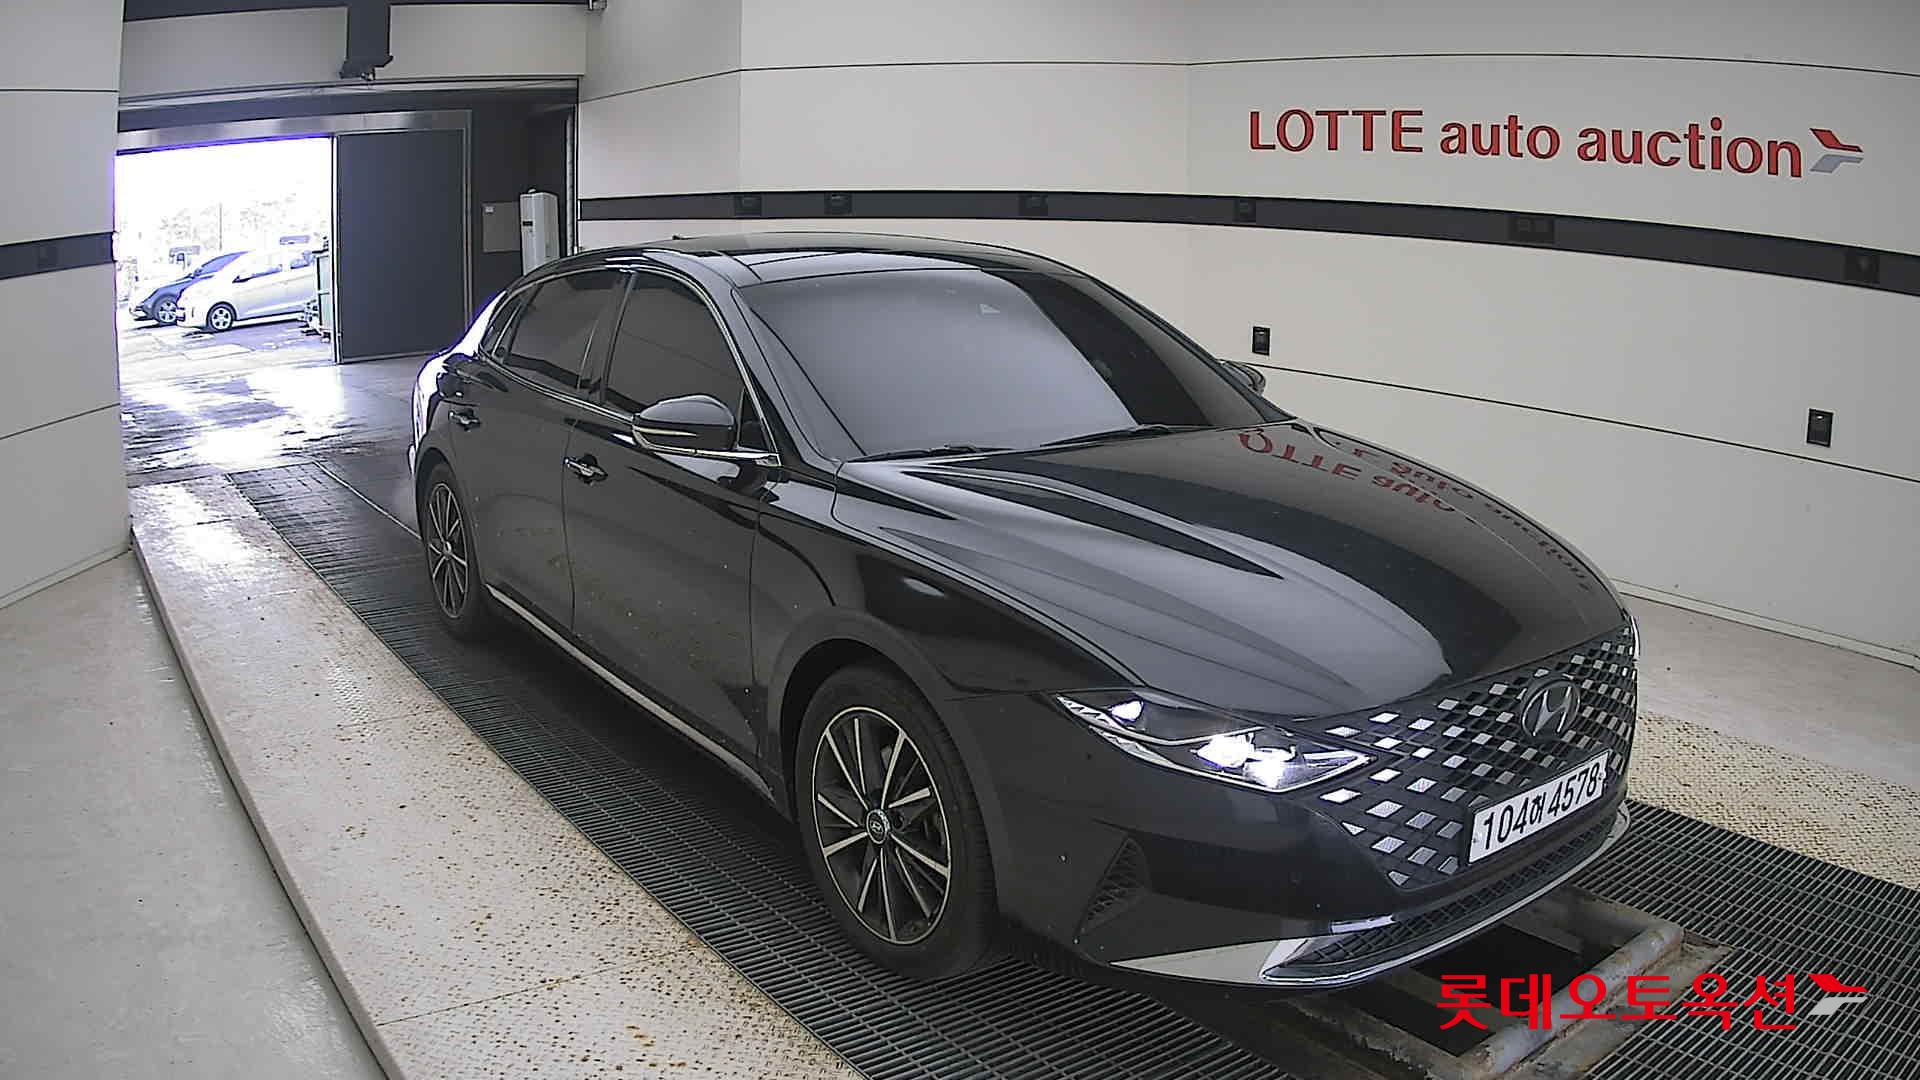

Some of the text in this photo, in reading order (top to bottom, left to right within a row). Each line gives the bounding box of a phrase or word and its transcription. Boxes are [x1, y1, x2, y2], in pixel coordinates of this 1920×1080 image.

[1249, 109, 1803, 178] LOTTE auto auction
[1547, 762, 1601, 817] 4578
